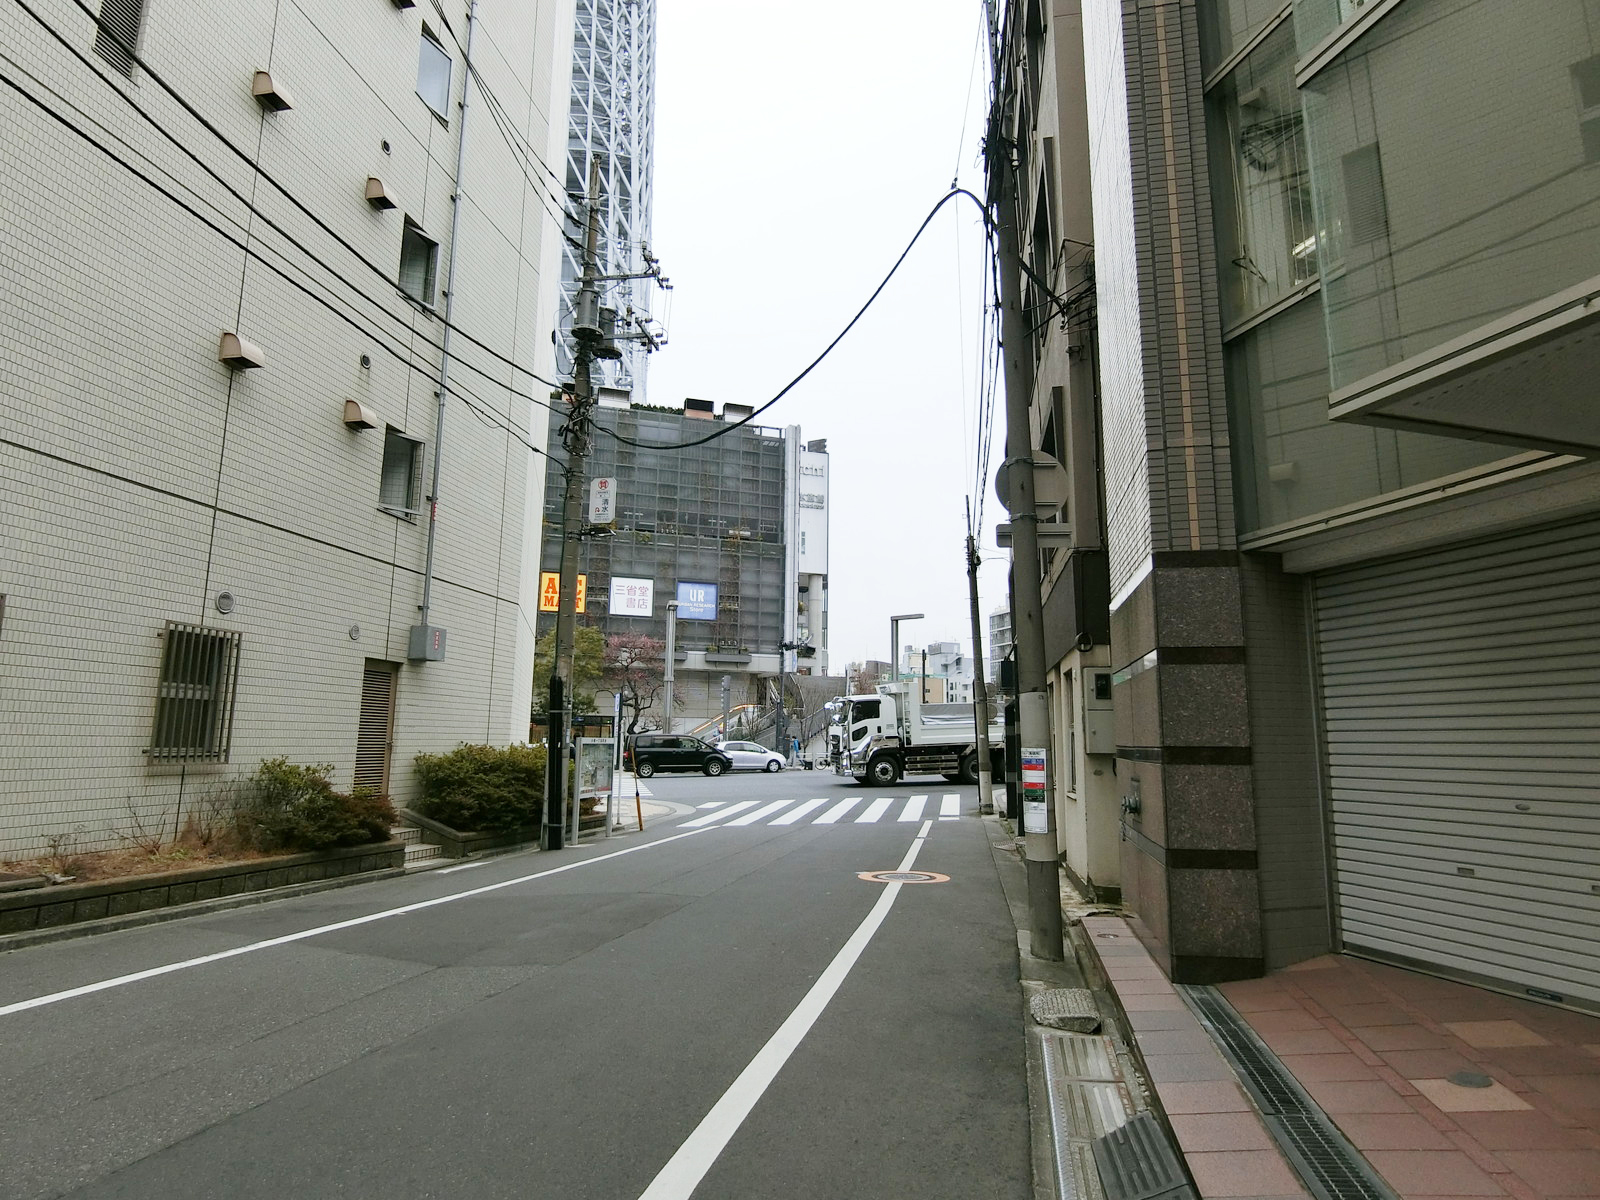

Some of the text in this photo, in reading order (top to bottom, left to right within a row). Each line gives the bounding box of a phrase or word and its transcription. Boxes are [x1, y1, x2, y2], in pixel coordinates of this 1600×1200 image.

[544, 577, 582, 596] AC
[615, 584, 649, 597] 三省堂
[543, 595, 582, 609] MT
[689, 589, 705, 602] UR
[626, 597, 648, 609] 書店
